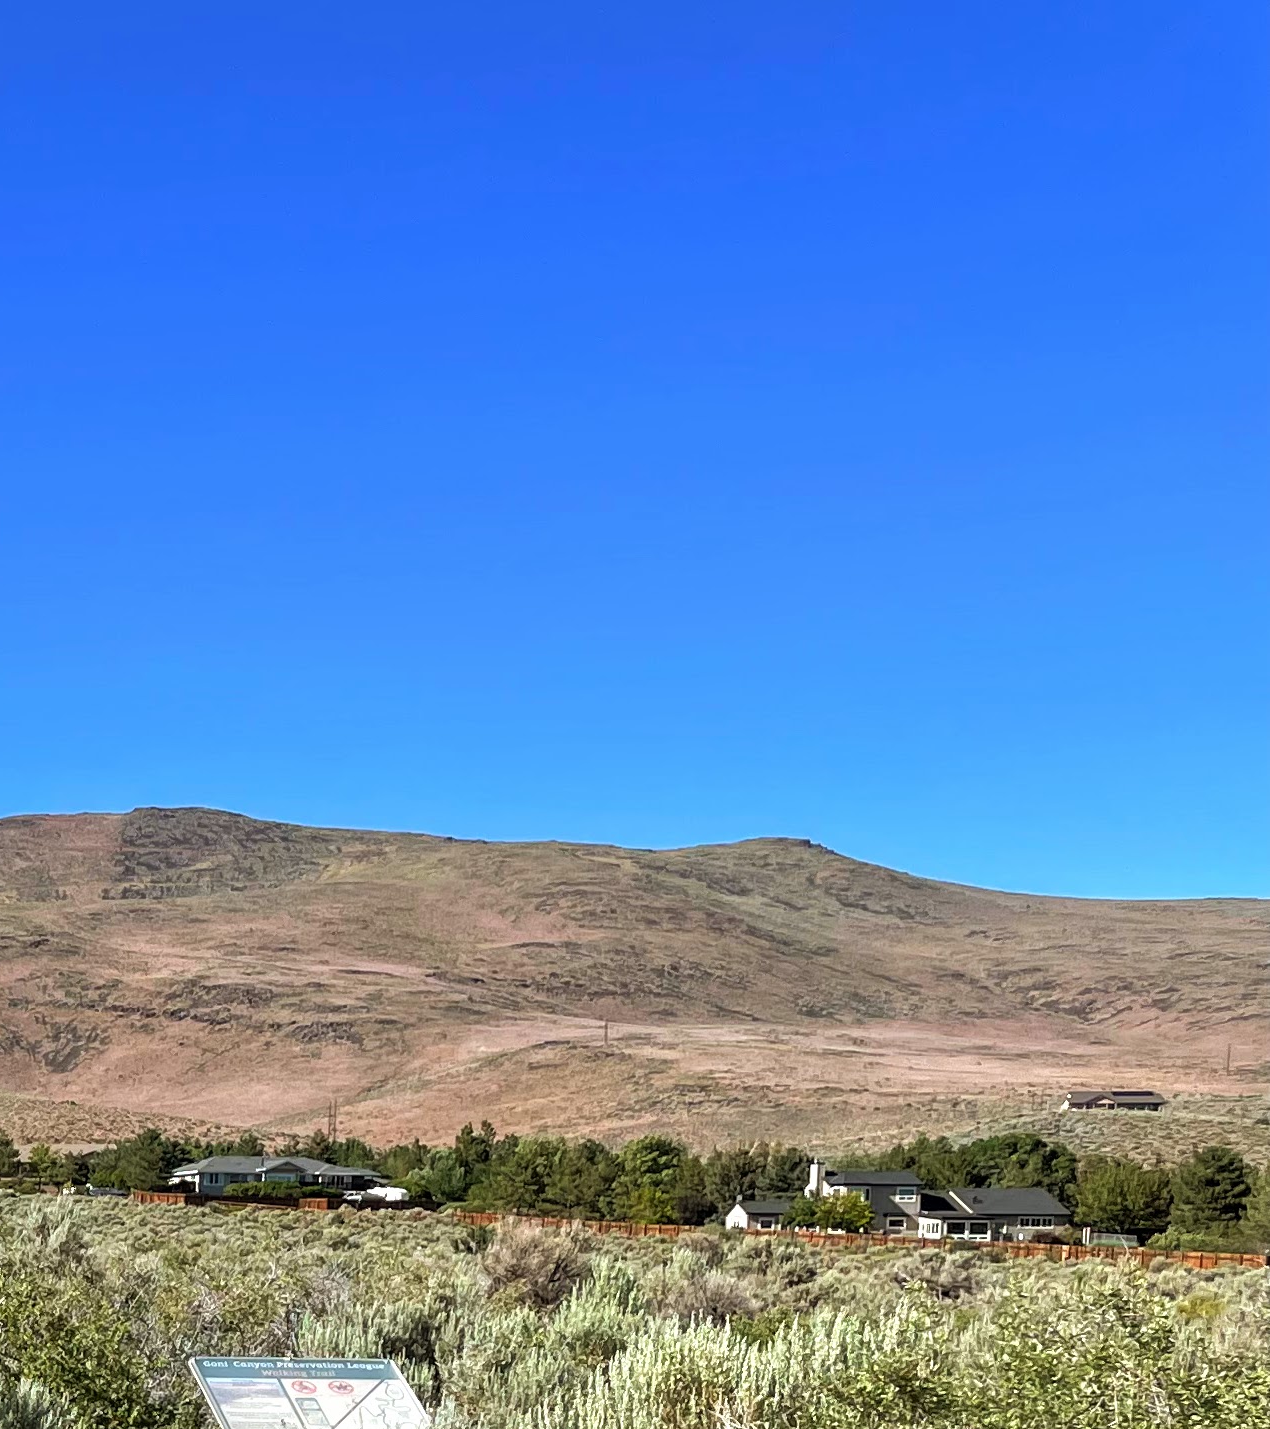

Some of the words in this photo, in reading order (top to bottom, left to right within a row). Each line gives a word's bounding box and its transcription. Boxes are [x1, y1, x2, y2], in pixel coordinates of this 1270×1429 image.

[233, 1360, 274, 1370] Canyon
[277, 1360, 345, 1370] Preservation
[347, 1362, 385, 1371] League
[261, 1369, 307, 1377] Walking
[310, 1369, 336, 1377] Trail
